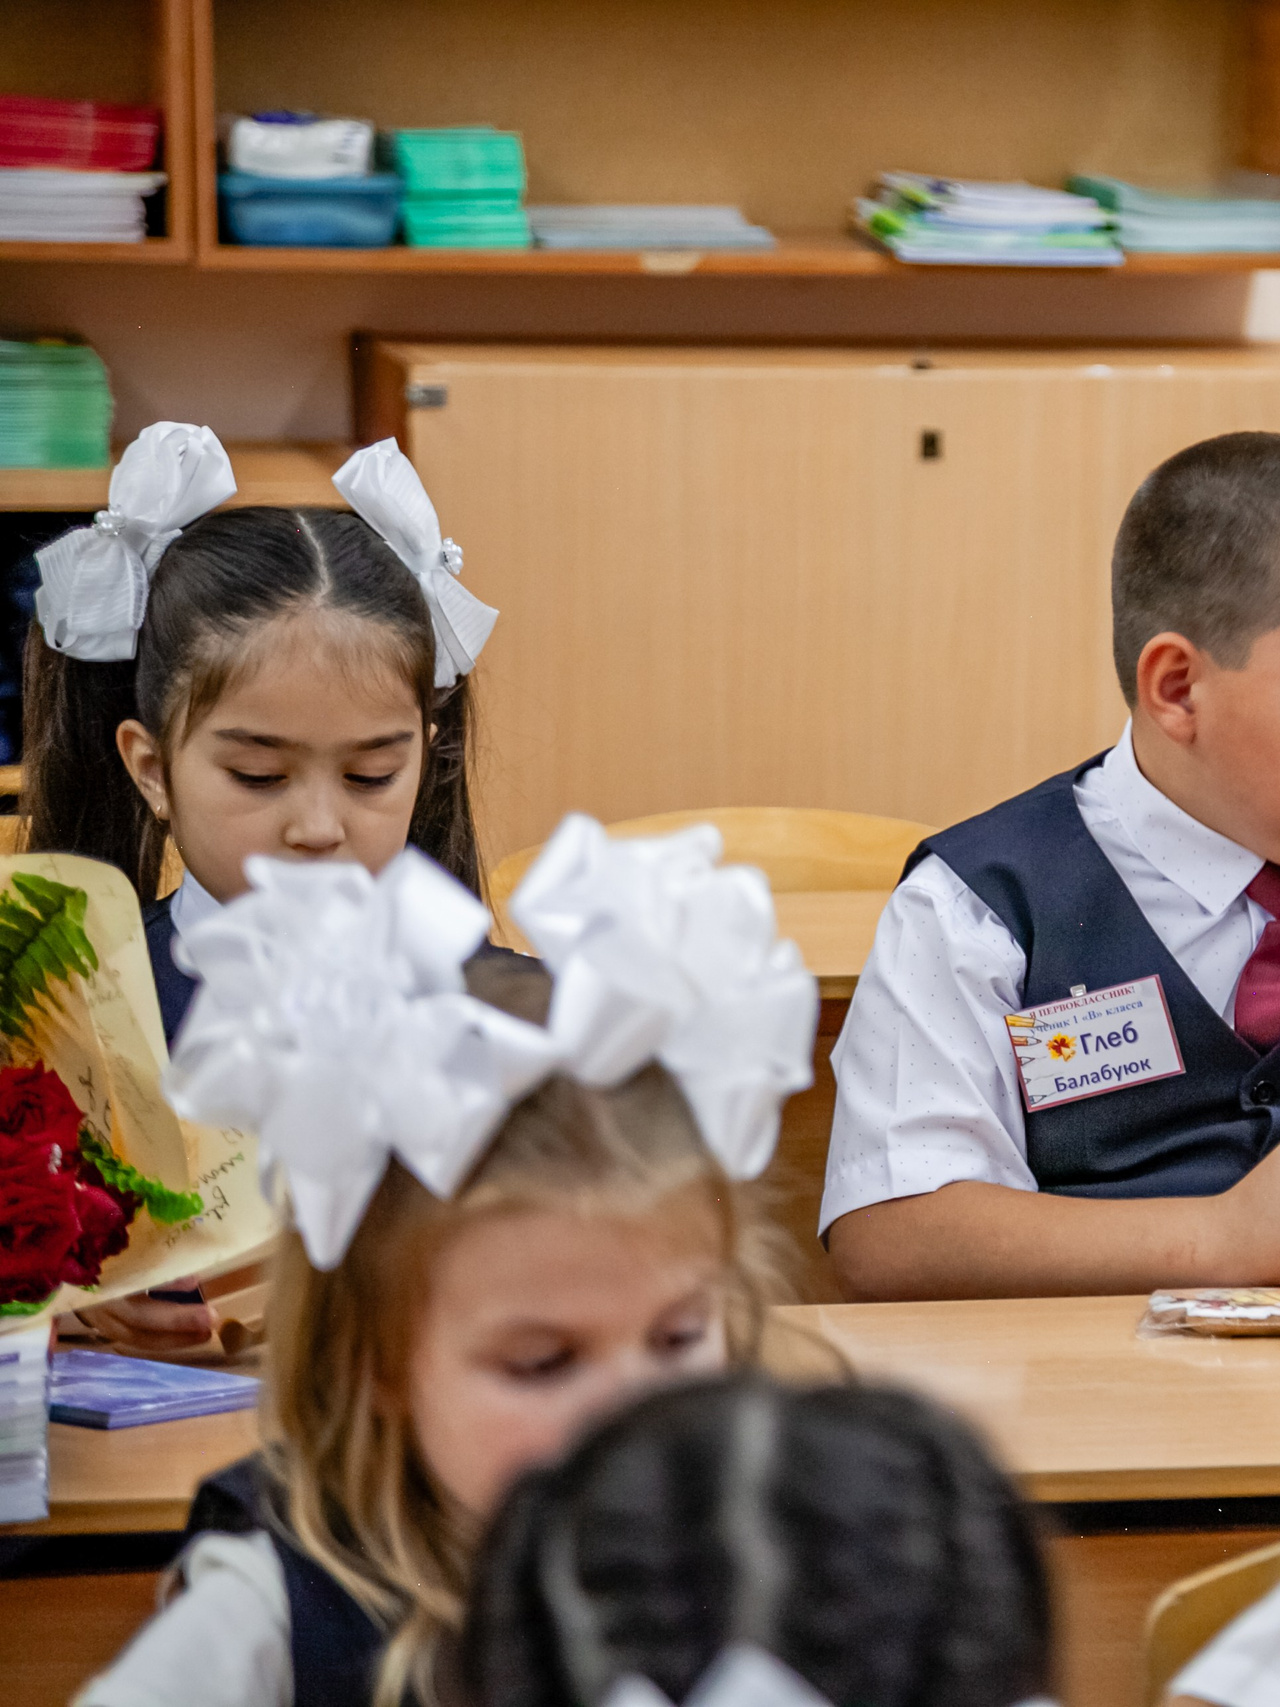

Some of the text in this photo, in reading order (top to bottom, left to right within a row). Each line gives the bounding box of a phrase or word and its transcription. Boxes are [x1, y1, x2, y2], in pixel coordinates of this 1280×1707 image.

[1039, 985, 1136, 1017] ПЕРВОКЛАССНИК!
[1105, 1000, 1143, 1016] класса
[1080, 1020, 1138, 1055] Глеб
[1054, 1058, 1152, 1093] Балабуюк
